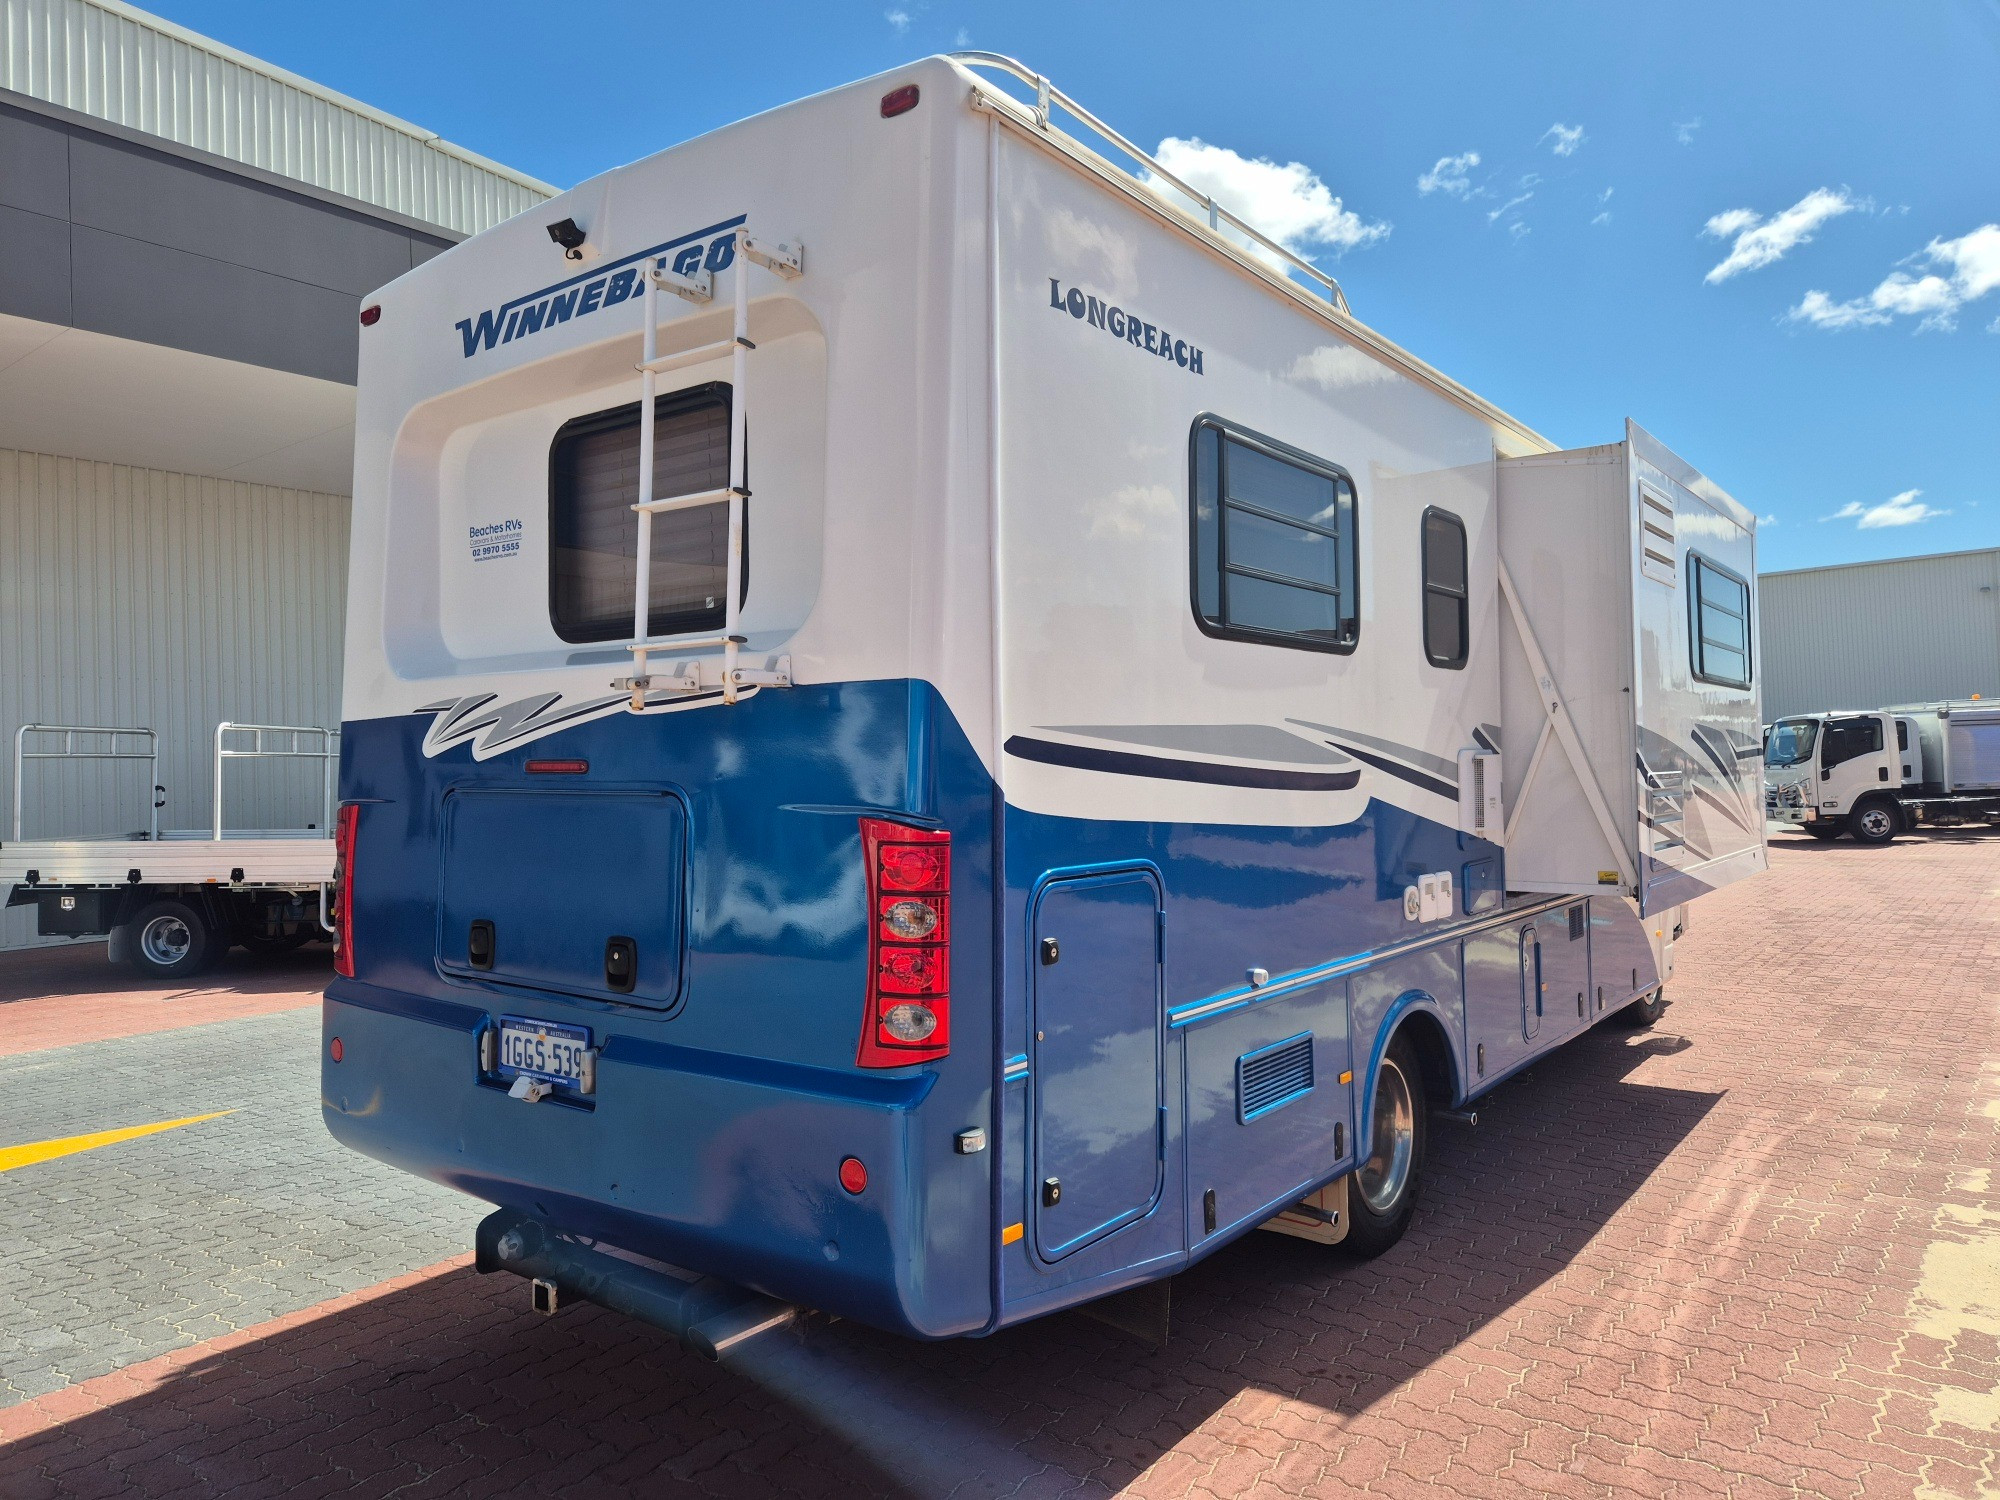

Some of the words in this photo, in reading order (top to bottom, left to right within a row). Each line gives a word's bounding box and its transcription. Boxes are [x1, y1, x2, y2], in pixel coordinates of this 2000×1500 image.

[1049, 278, 1204, 376] LONGREACH
[469, 524, 504, 538] Beaches
[505, 519, 522, 532] RVs
[472, 549, 481, 557] 02
[482, 545, 500, 555] 9970
[501, 542, 520, 552] 5555
[515, 1025, 535, 1033] WESTERN
[550, 1031, 572, 1039] AUSTRALIA
